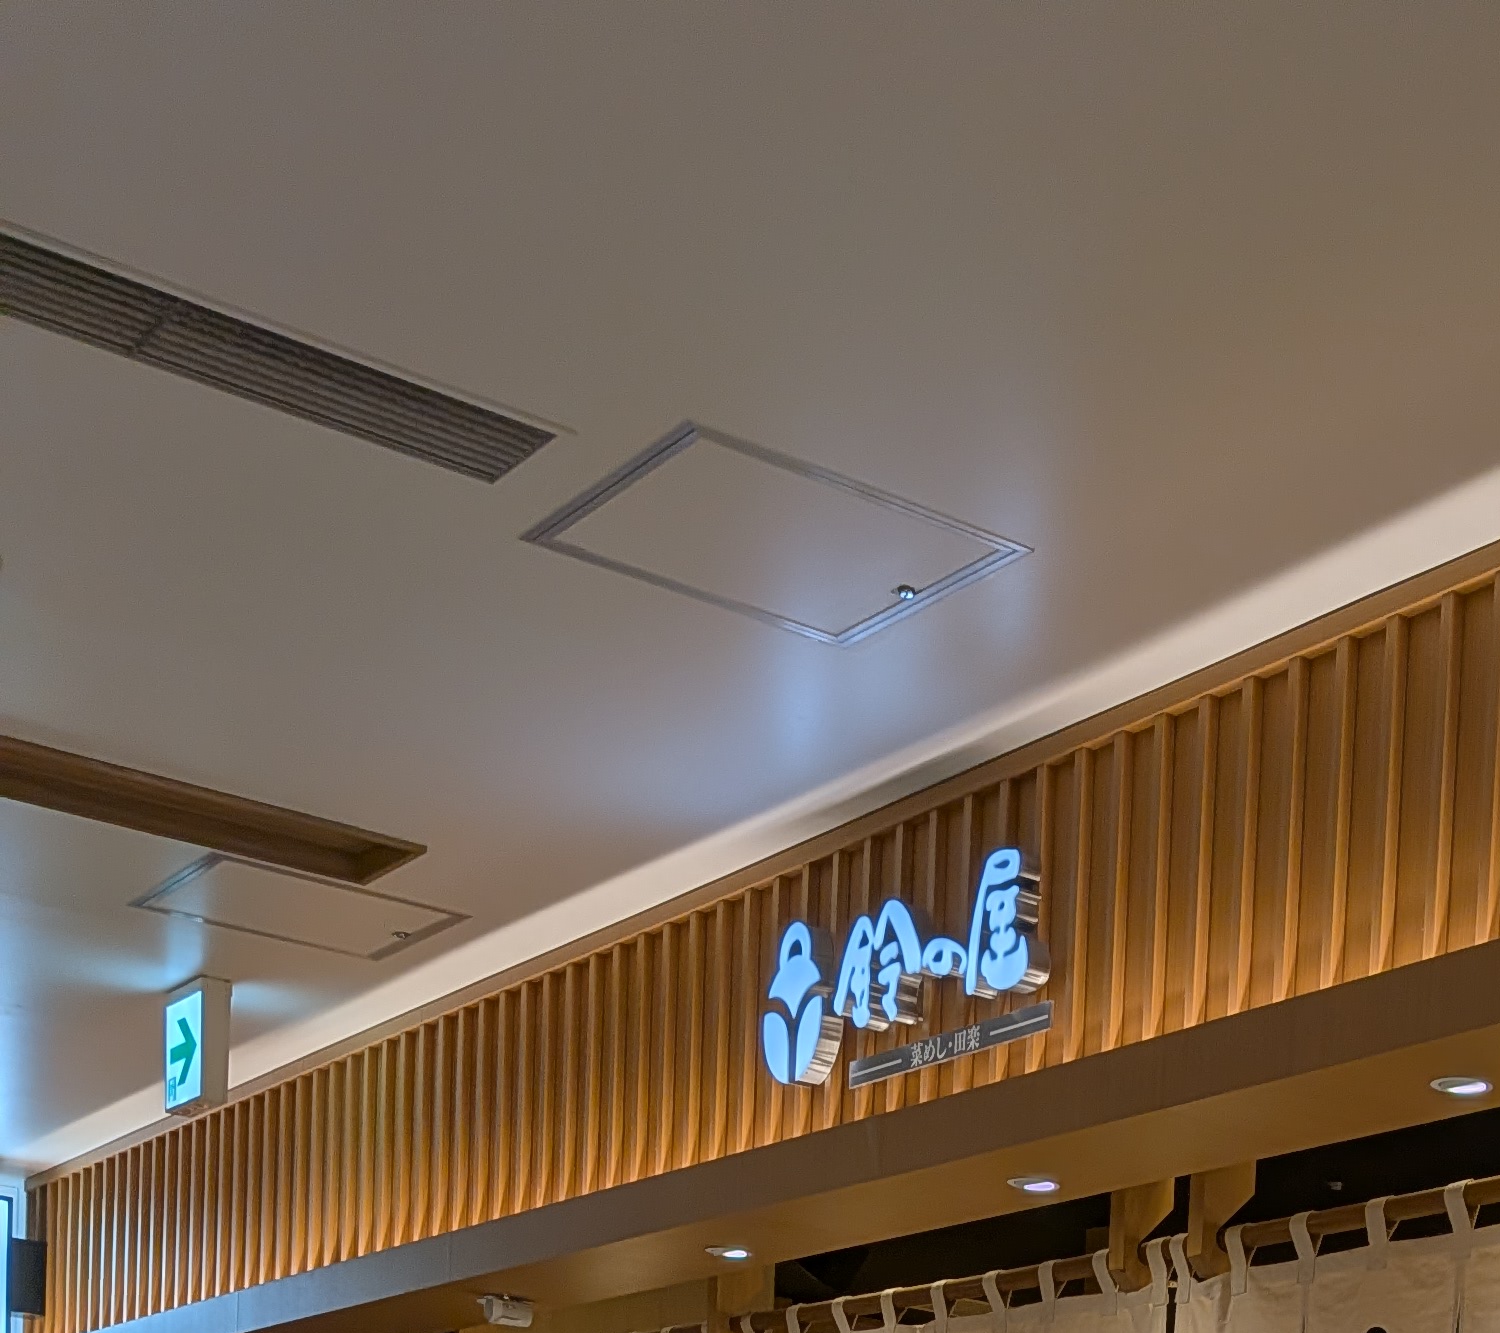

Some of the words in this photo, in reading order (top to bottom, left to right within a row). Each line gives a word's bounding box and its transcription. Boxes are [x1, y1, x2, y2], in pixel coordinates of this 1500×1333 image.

[834, 848, 1029, 1029] 鈴の屋
[910, 1024, 981, 1068] 菜めし・田楽
